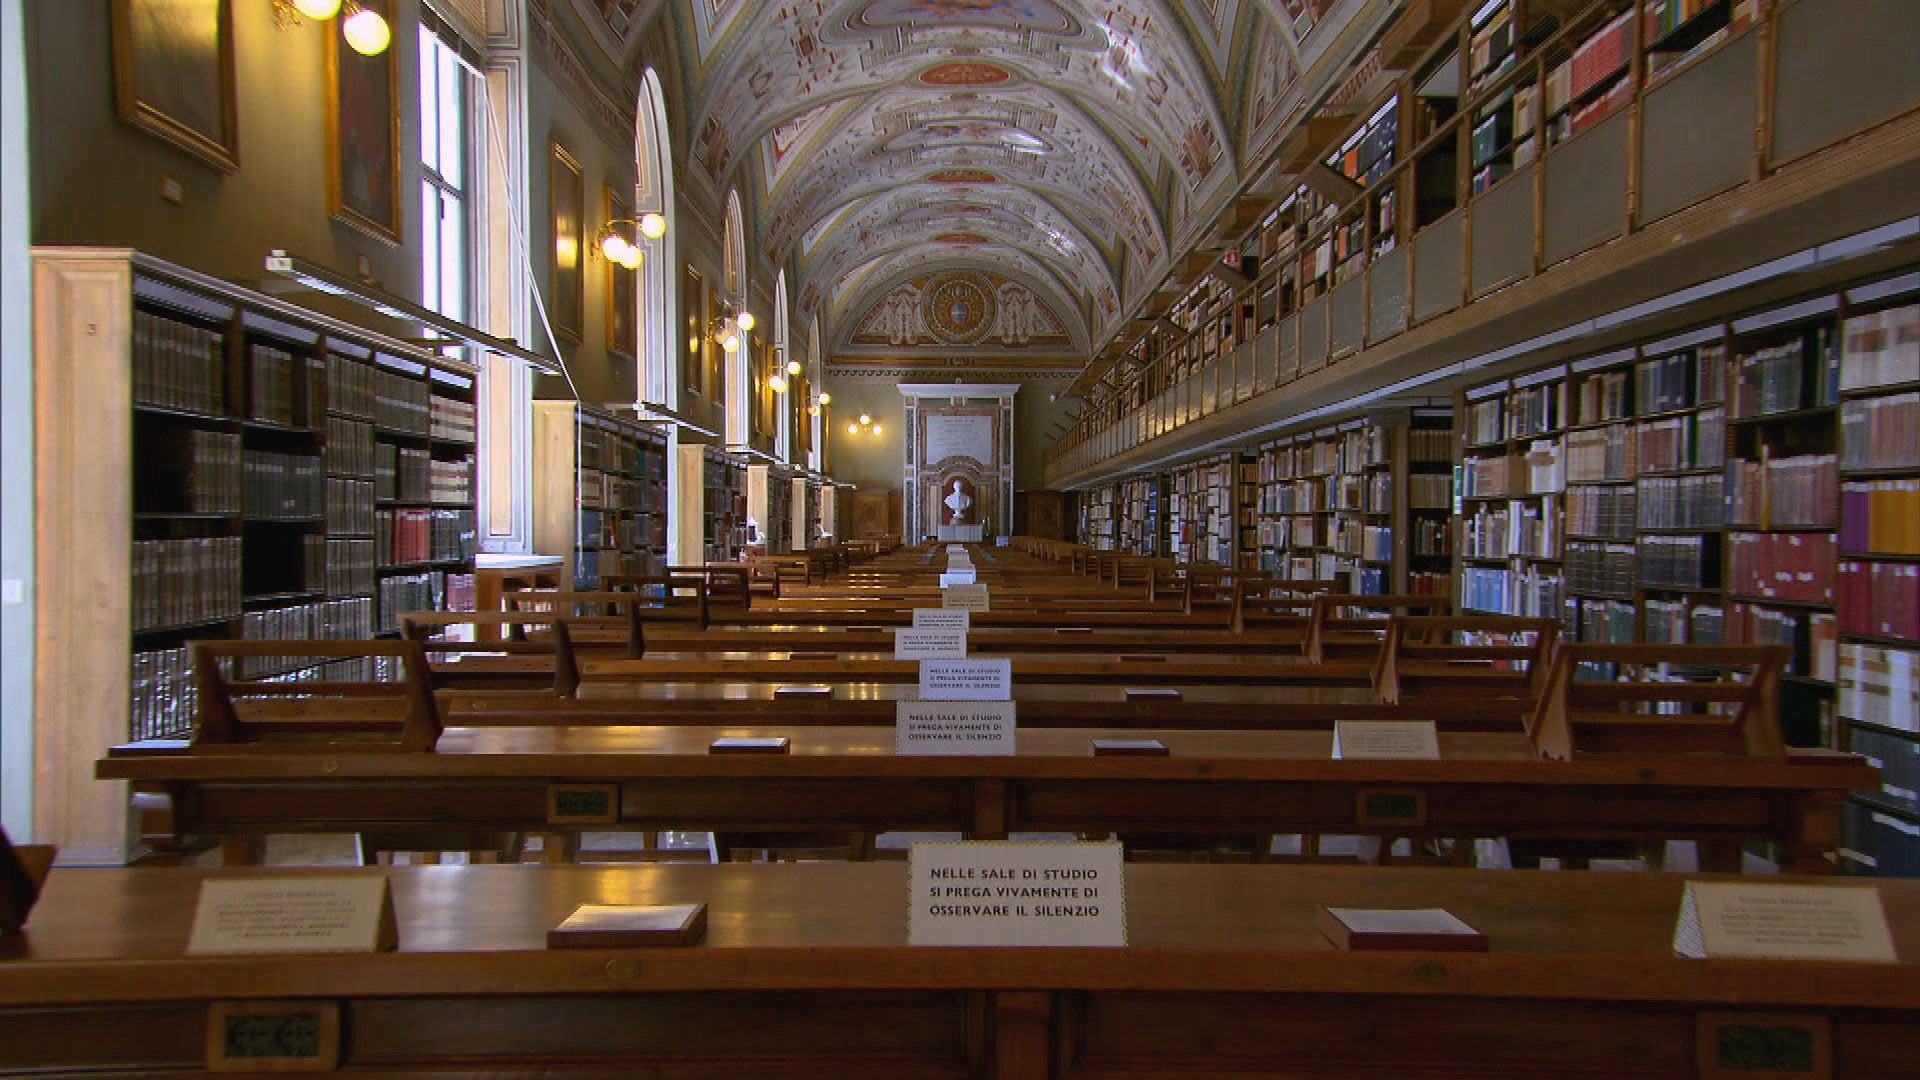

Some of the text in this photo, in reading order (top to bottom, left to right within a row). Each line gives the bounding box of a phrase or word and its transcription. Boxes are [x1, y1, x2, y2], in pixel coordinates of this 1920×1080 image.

[908, 723, 1002, 731] SI PREGA VIVAMENTE DI
[908, 733, 1002, 741] OSSERVARE IL SILENZIO
[930, 867, 1098, 879] NELLE SALE DI STUDIO
[929, 887, 1098, 898] SI PREGA VIVAMENTE DI
[928, 905, 1100, 917] OSSERVARE IL SILENZIO
